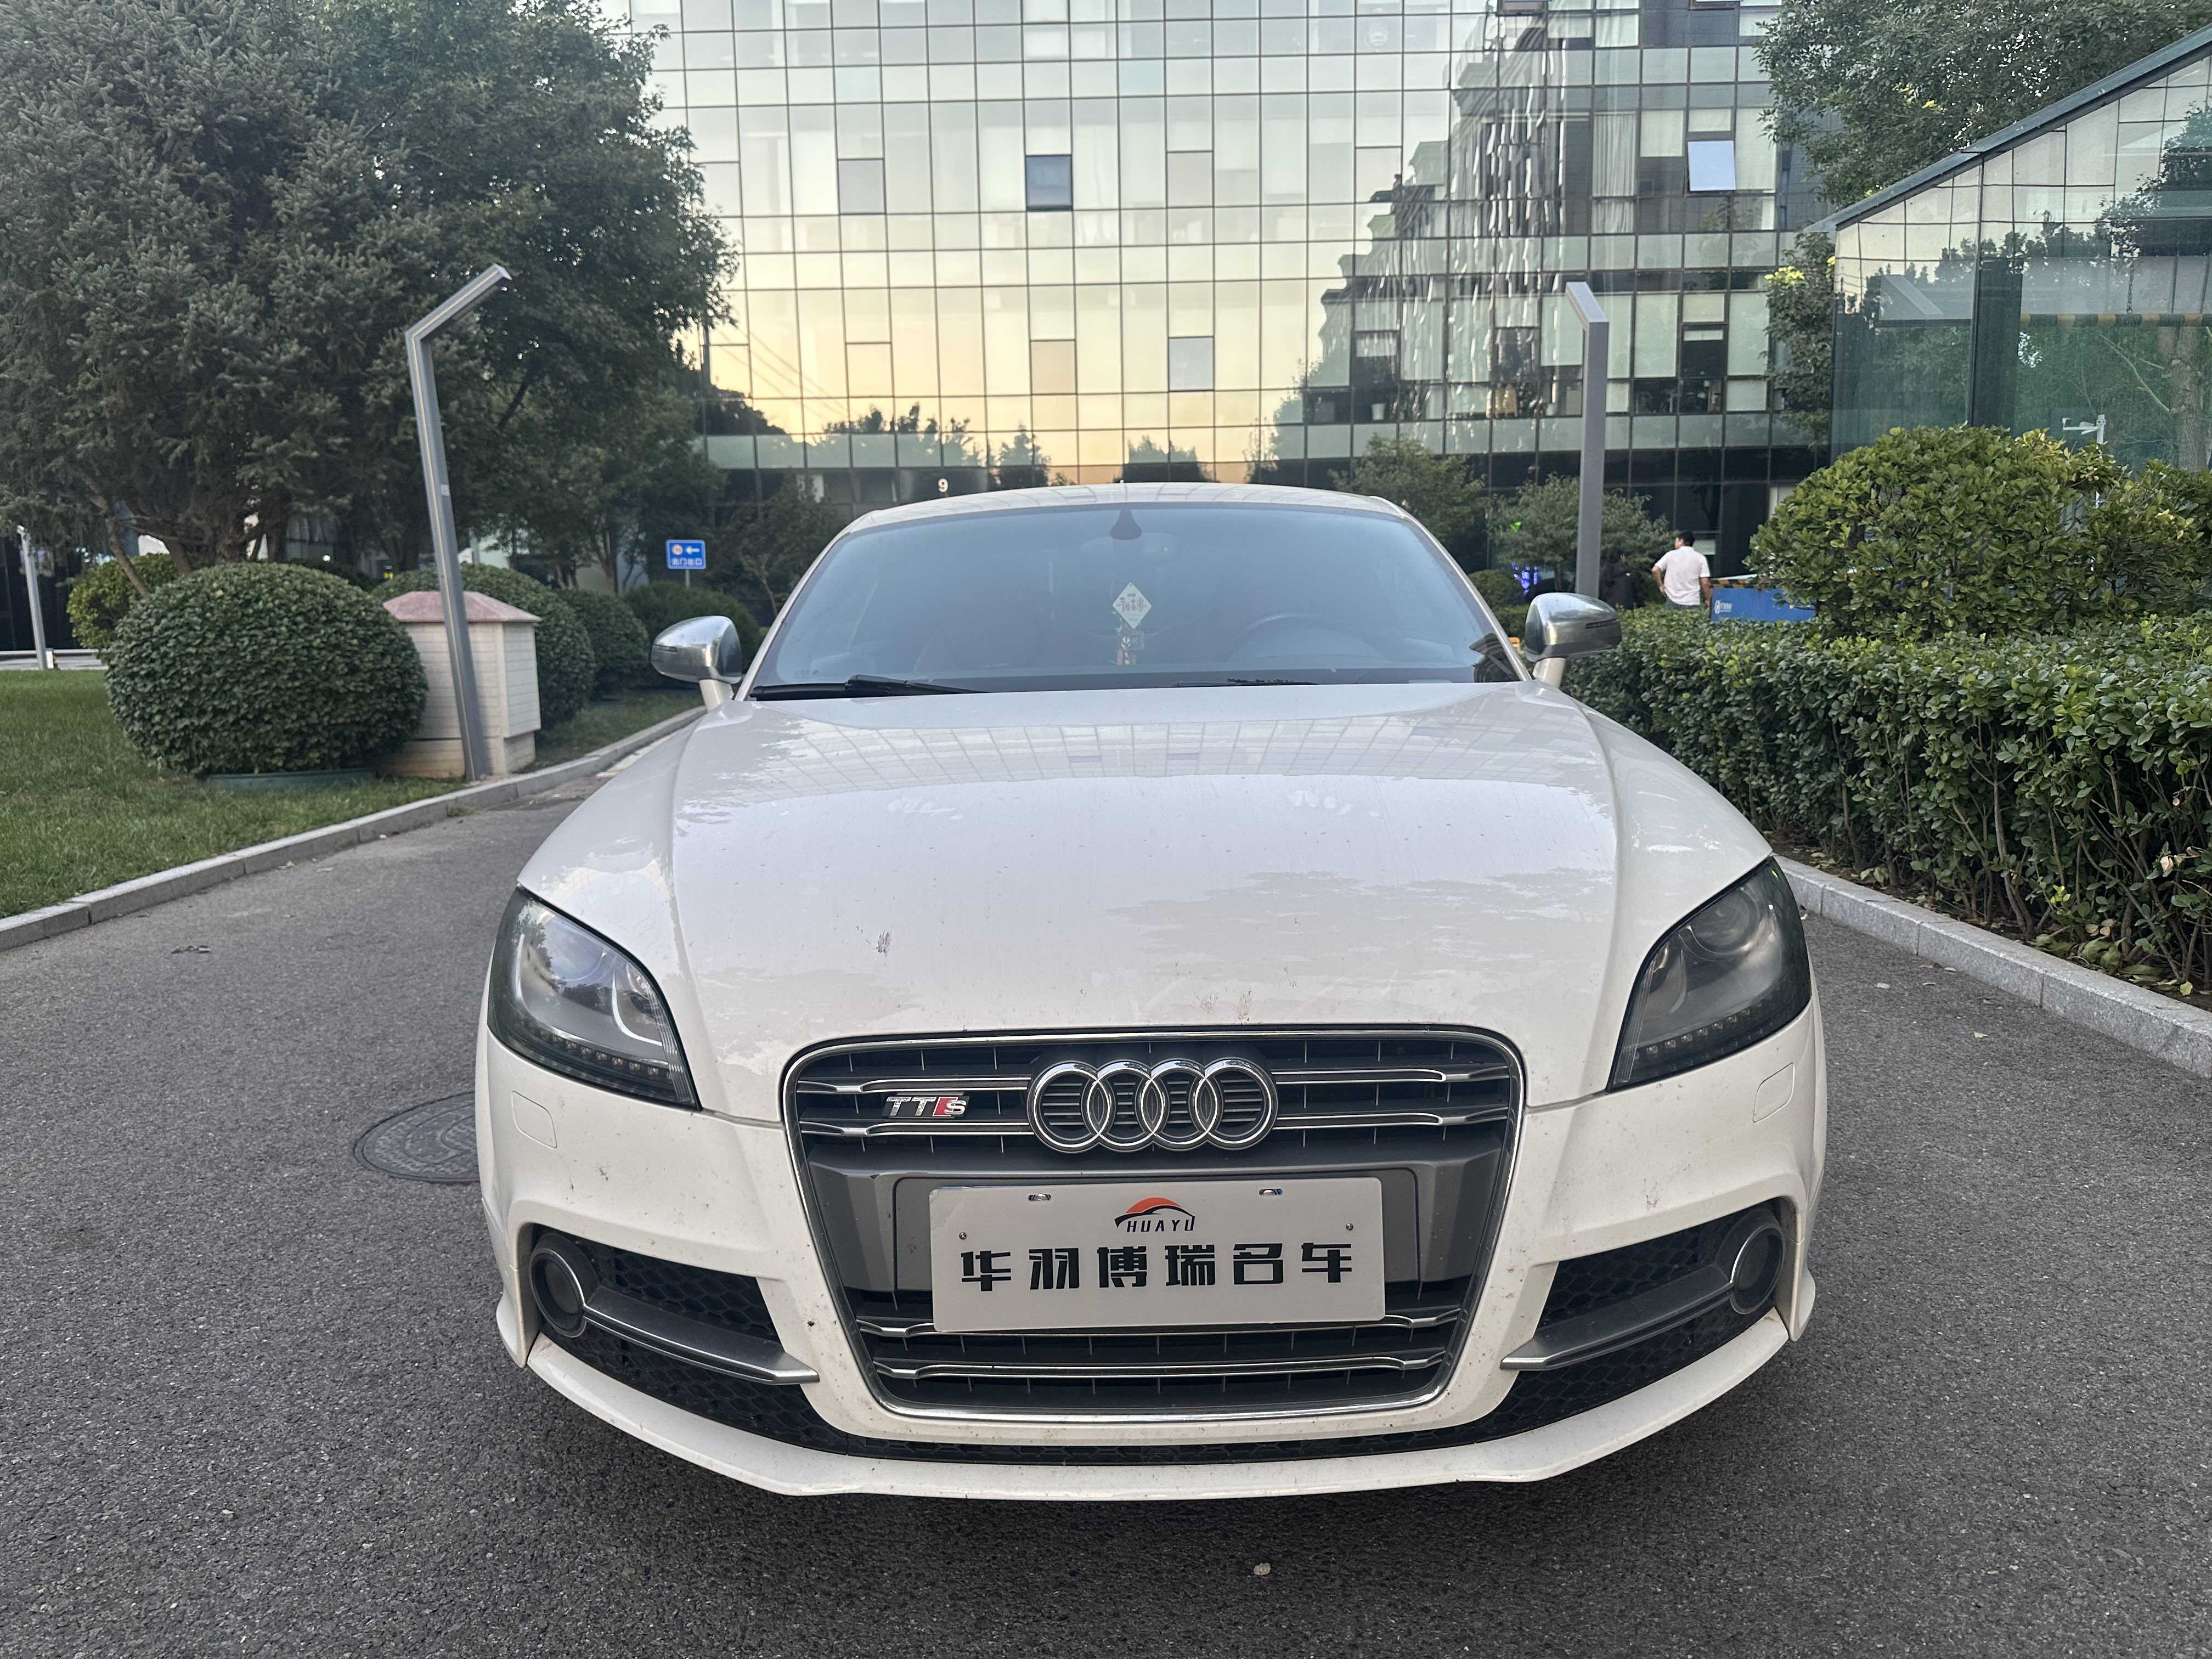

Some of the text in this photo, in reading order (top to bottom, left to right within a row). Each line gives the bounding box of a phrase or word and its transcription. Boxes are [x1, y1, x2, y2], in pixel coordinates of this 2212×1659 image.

[938, 478, 948, 493] 9
[1126, 1217, 1196, 1233] HUAYU
[961, 1242, 1352, 1291] 华羽博瑞名车
